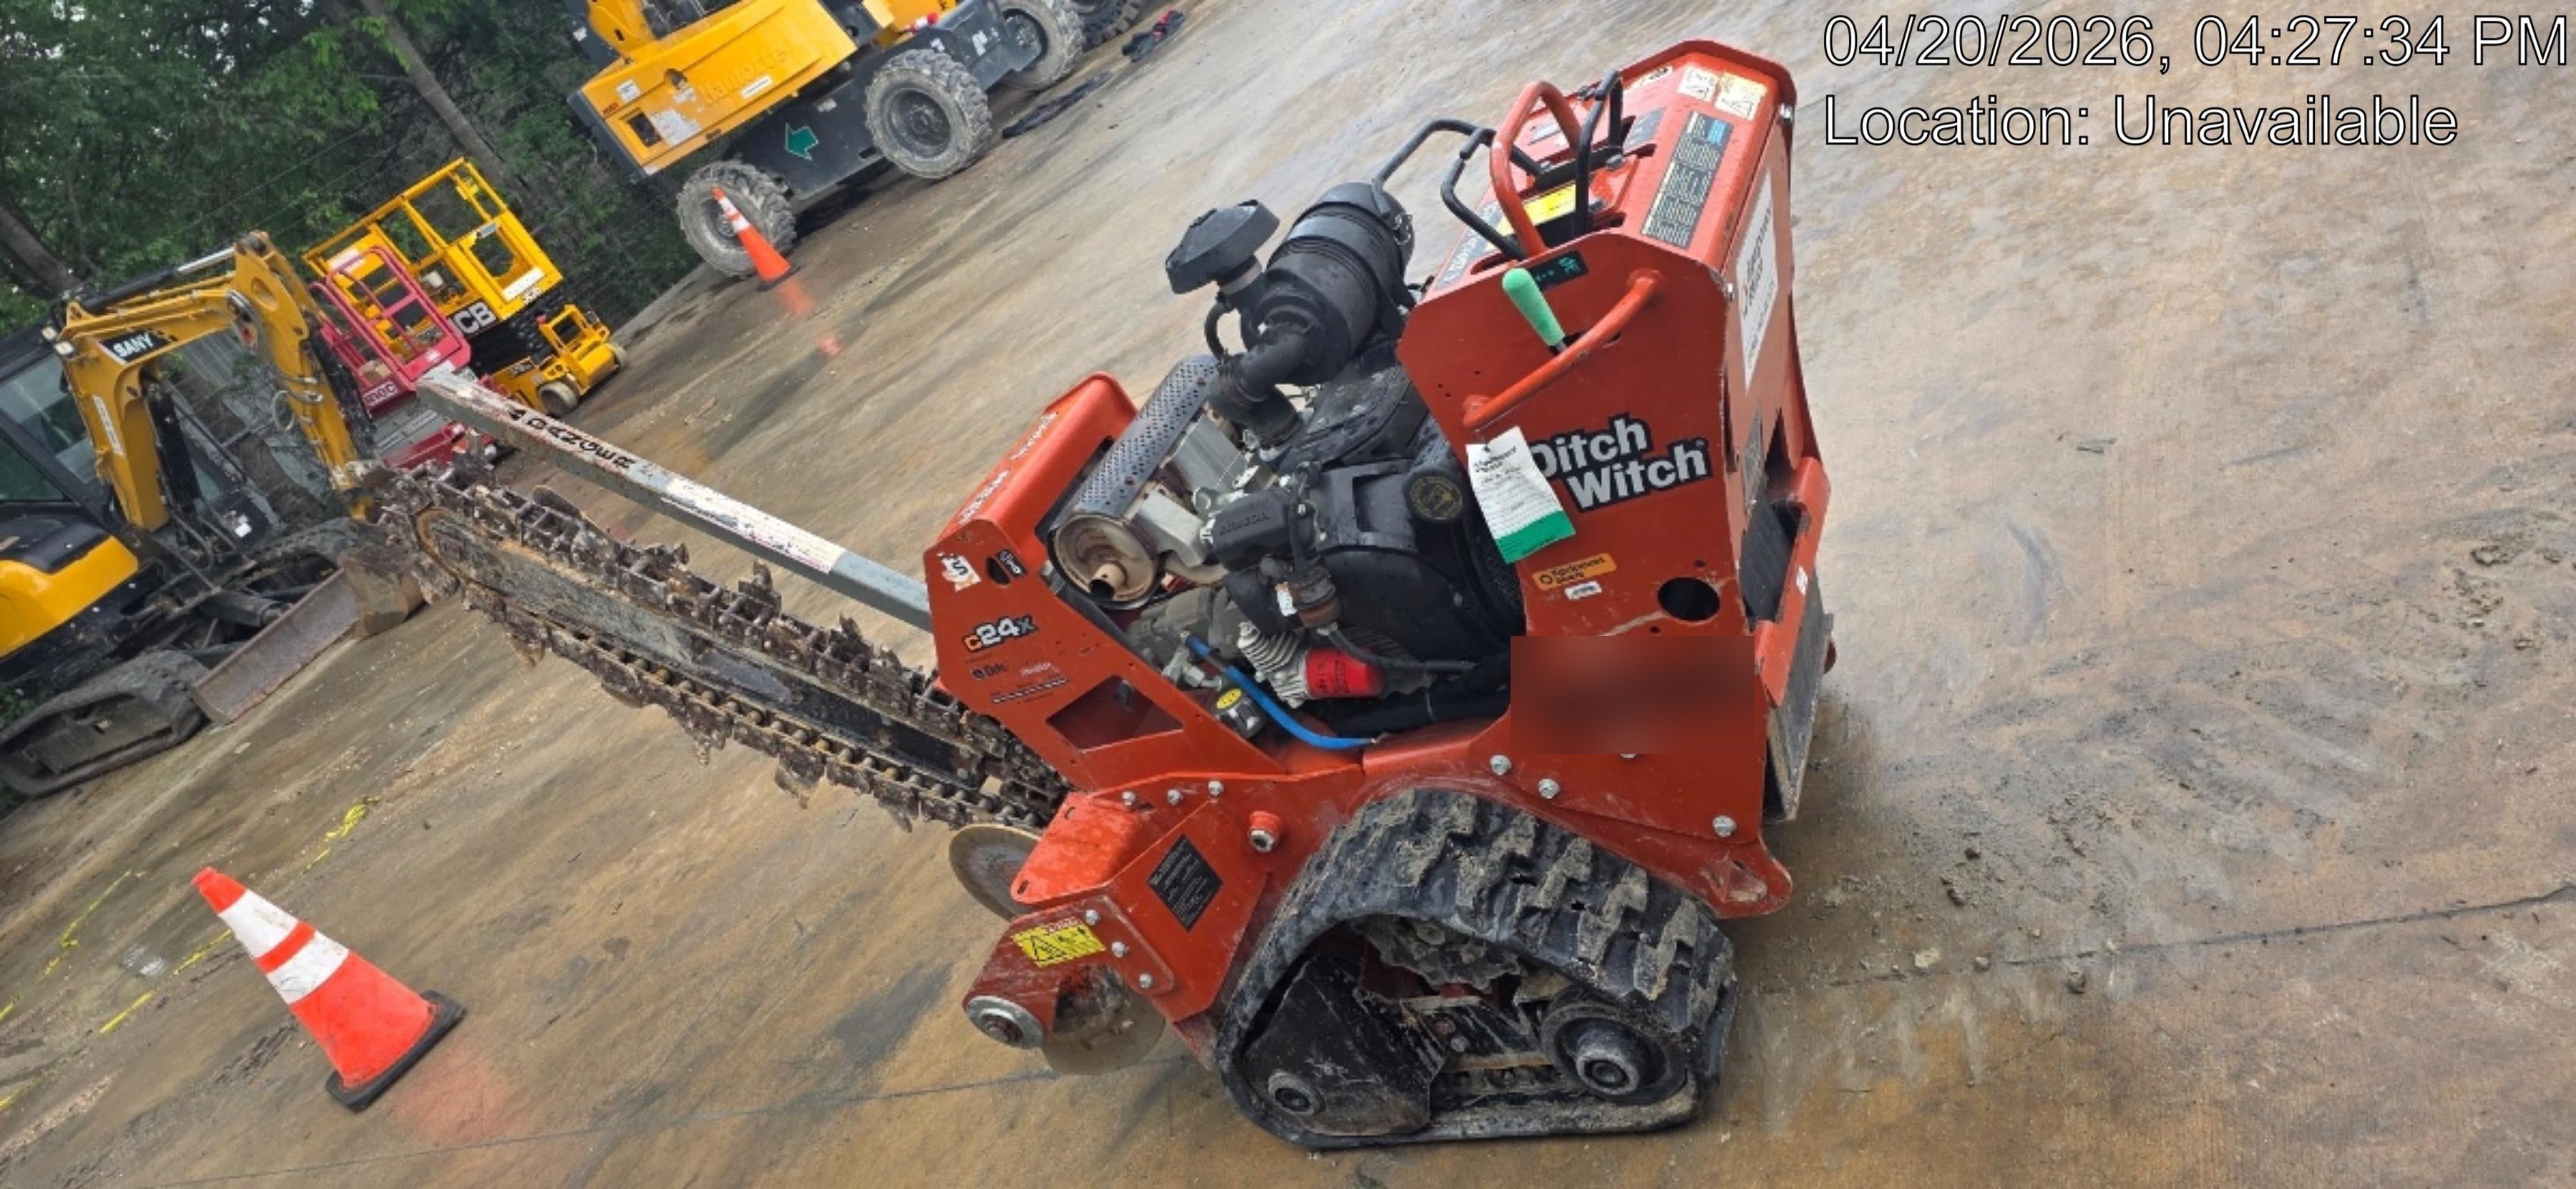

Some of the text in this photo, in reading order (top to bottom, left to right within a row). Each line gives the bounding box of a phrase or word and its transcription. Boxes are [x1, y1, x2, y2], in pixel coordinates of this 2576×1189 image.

[452, 301, 497, 333] CB
[1529, 418, 1648, 479] Ditch
[1566, 443, 1708, 509] Witch
